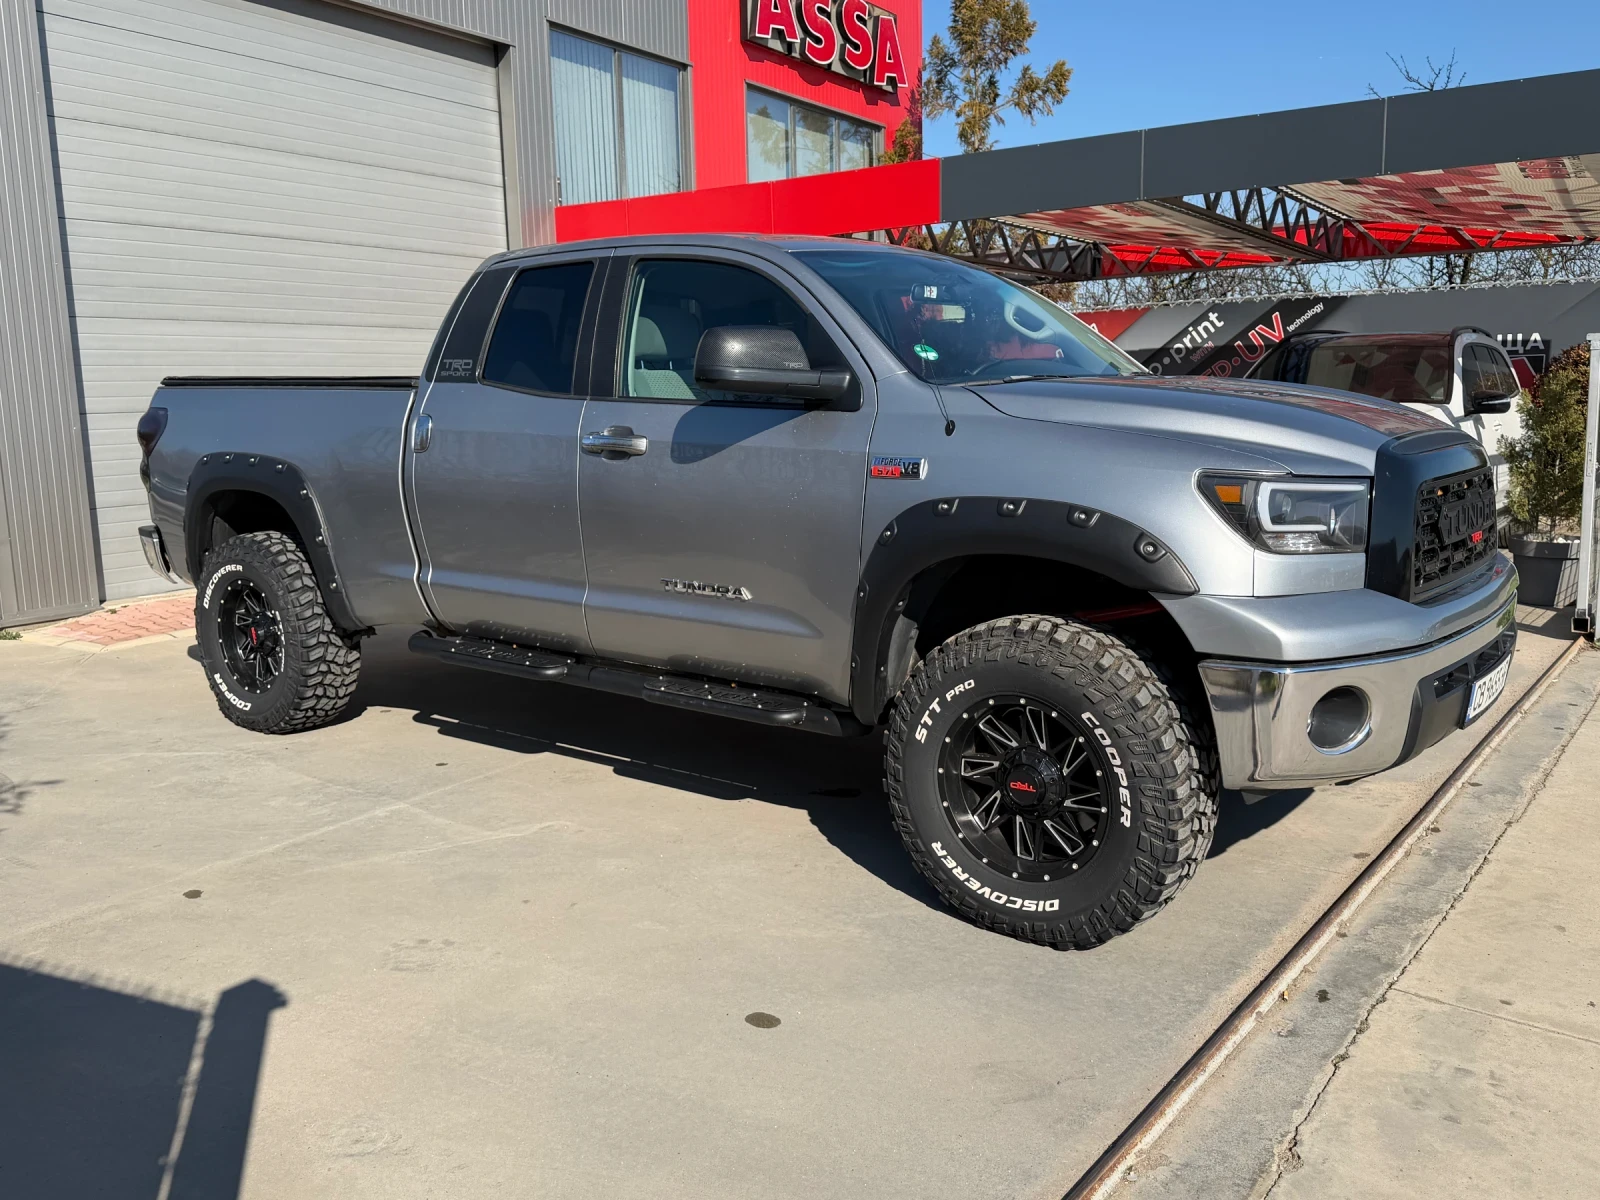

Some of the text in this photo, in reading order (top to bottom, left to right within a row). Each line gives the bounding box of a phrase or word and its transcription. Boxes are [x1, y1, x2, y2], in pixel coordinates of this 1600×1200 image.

[755, 0, 908, 88] ASSA
[1286, 302, 1324, 333] technology
[443, 359, 473, 372] TRD
[902, 461, 920, 474] V8
[203, 564, 243, 609] DISCOVERER
[660, 577, 753, 602] TUNDRA
[214, 673, 252, 711] COOPER
[915, 679, 975, 744] STT PRO
[1081, 711, 1131, 828] COOPER
[931, 841, 1060, 912] DISCOVERER
